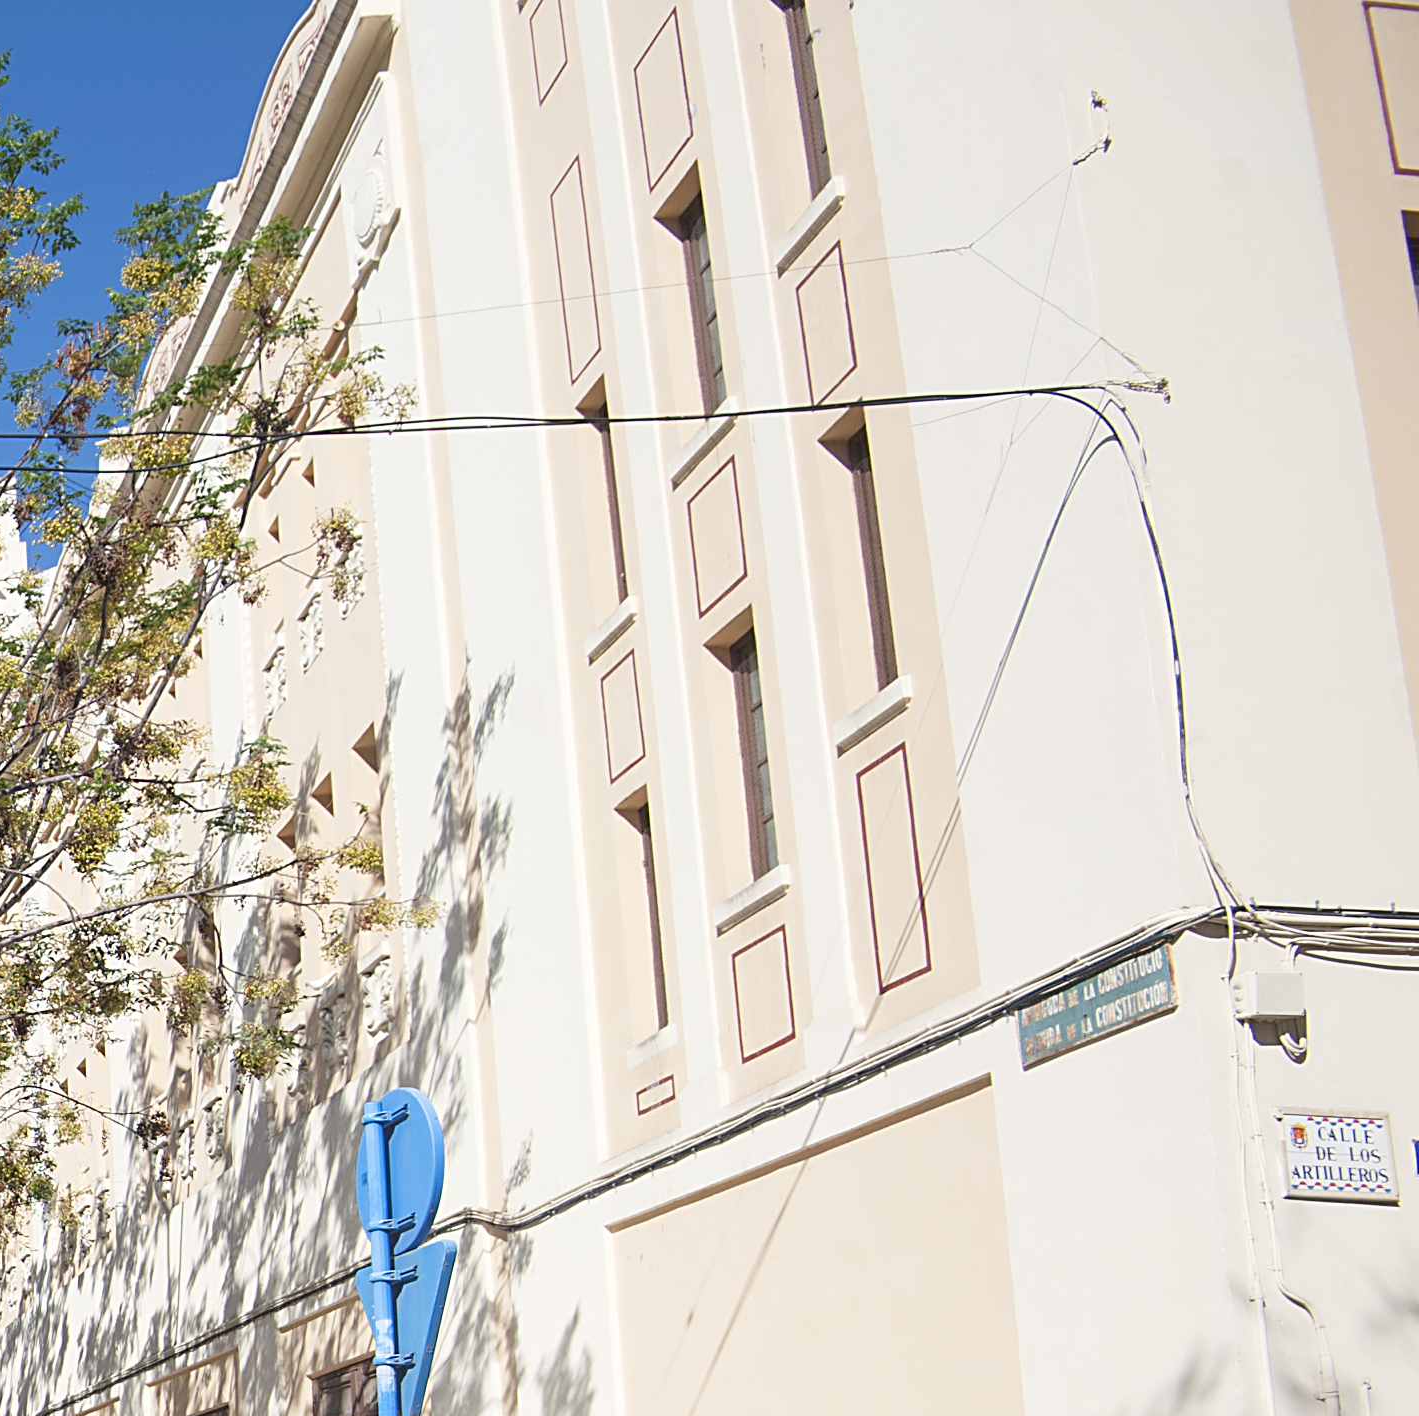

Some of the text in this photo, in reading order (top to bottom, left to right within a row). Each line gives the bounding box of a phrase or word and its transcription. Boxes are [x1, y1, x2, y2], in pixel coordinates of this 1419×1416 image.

[1083, 982, 1096, 1001] LA
[1081, 1018, 1094, 1034] LA
[1317, 1126, 1375, 1145] CALLE
[1315, 1146, 1382, 1164] DE LOS
[1291, 1164, 1389, 1184] ARTILLEROS
